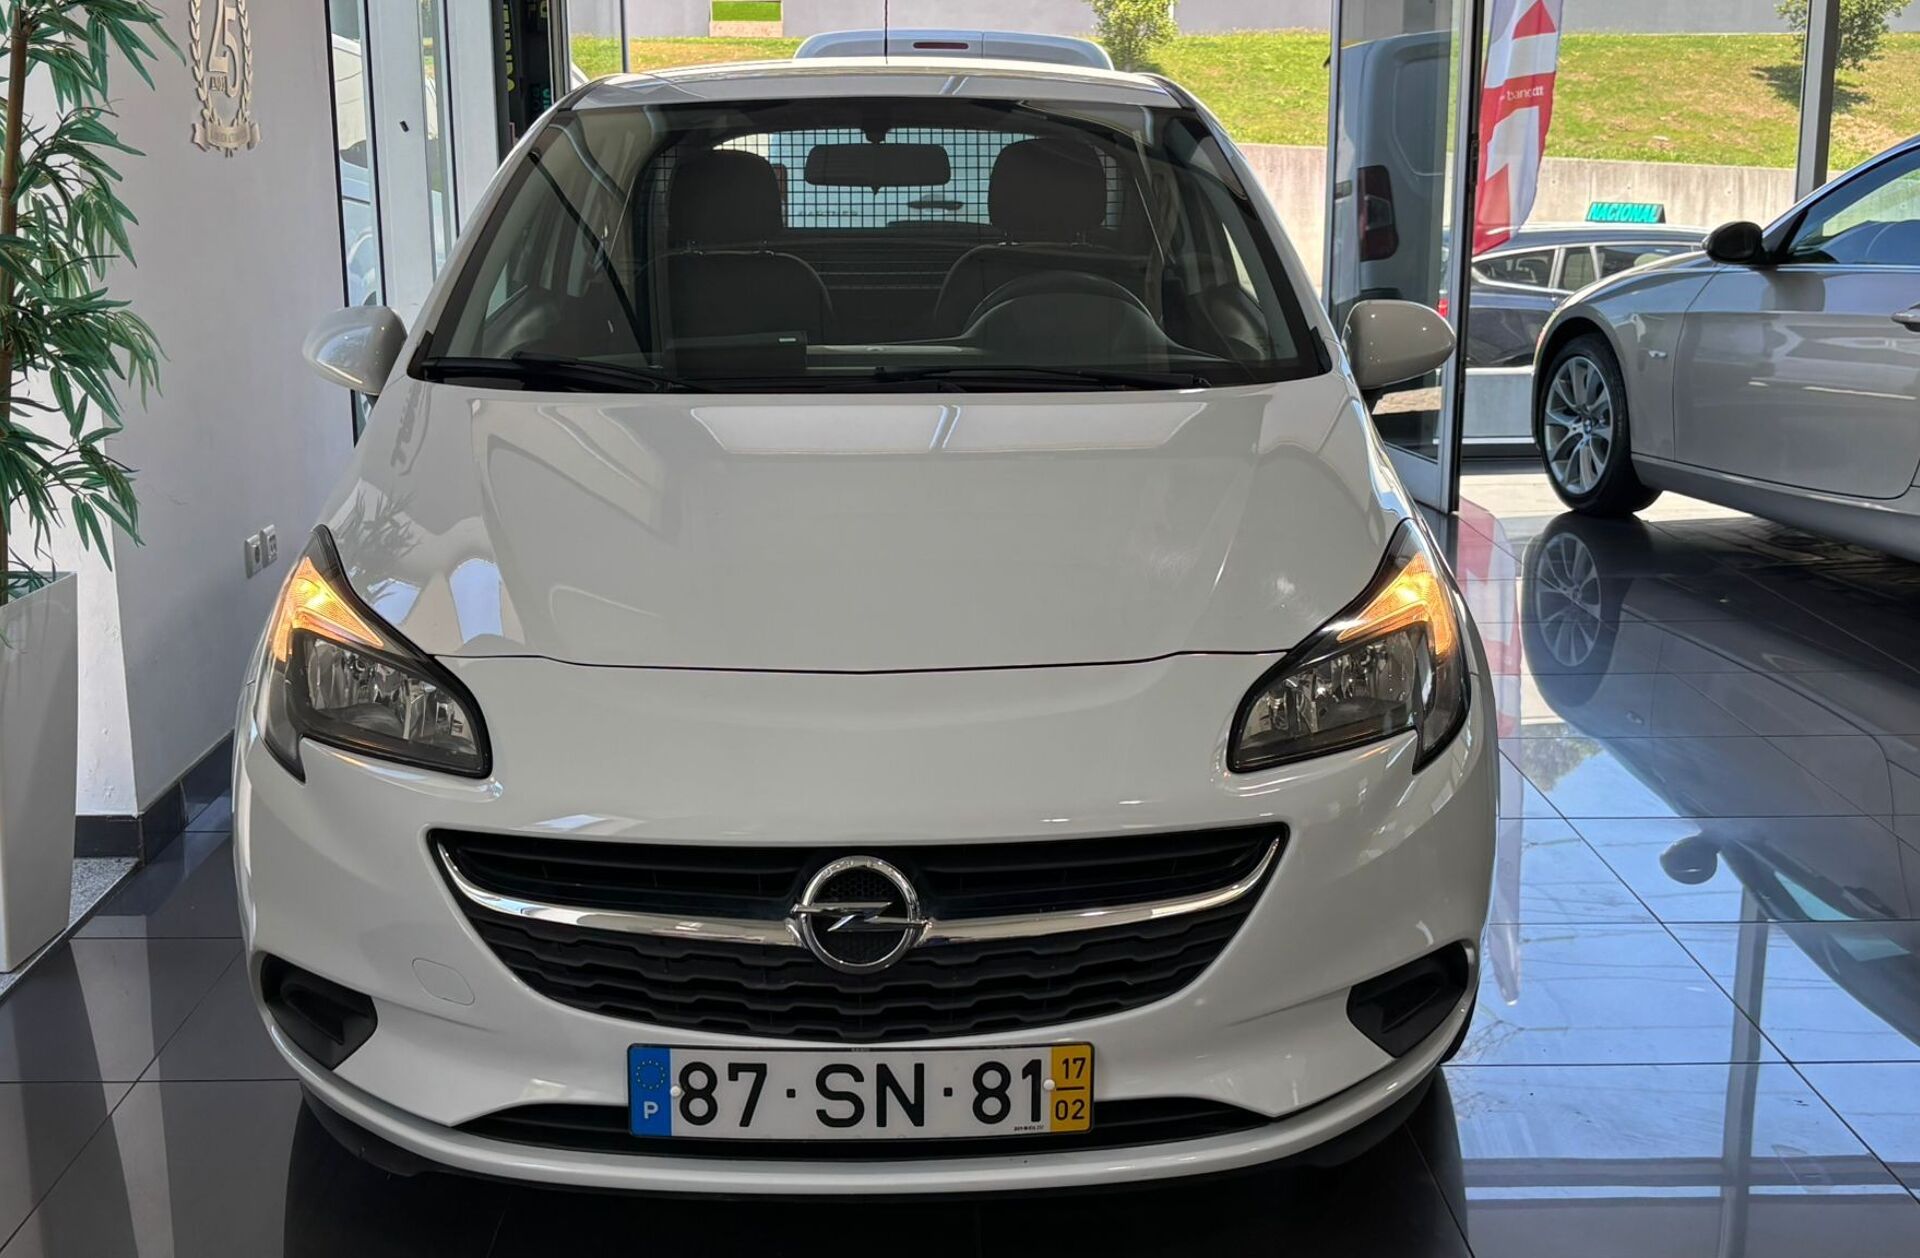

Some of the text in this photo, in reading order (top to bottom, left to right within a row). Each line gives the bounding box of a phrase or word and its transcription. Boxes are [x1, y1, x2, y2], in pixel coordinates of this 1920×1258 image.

[1588, 203, 1658, 223] NACIONAL
[1062, 1057, 1086, 1079] 17
[643, 1101, 659, 1119] P
[1055, 1099, 1085, 1120] 02
